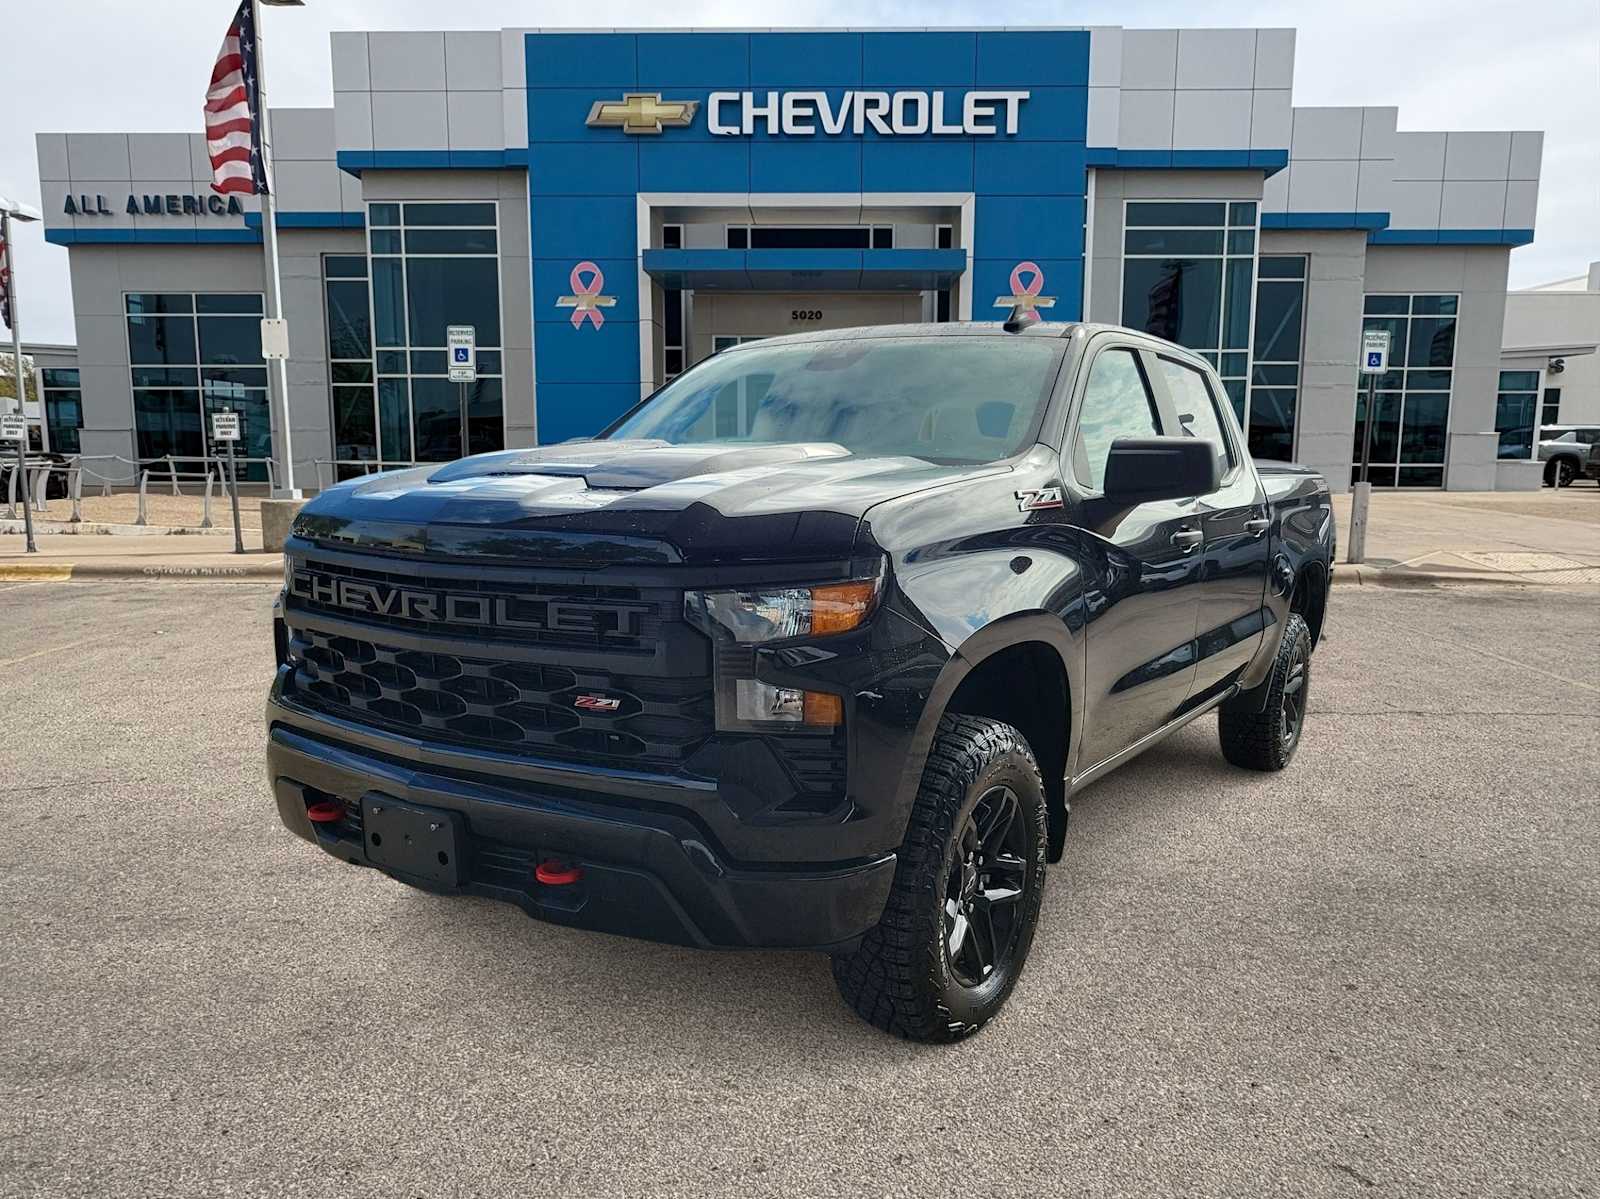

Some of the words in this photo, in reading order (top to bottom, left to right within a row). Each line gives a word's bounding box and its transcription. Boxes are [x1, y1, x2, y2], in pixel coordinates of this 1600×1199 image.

[707, 91, 1031, 135] CHEVROLET
[64, 194, 112, 215] ALL
[126, 194, 243, 215] AMERICA
[791, 309, 823, 321] 5020
[1014, 487, 1064, 512] Z71
[290, 572, 651, 636] CHEVROLET
[574, 695, 621, 711] Z71
